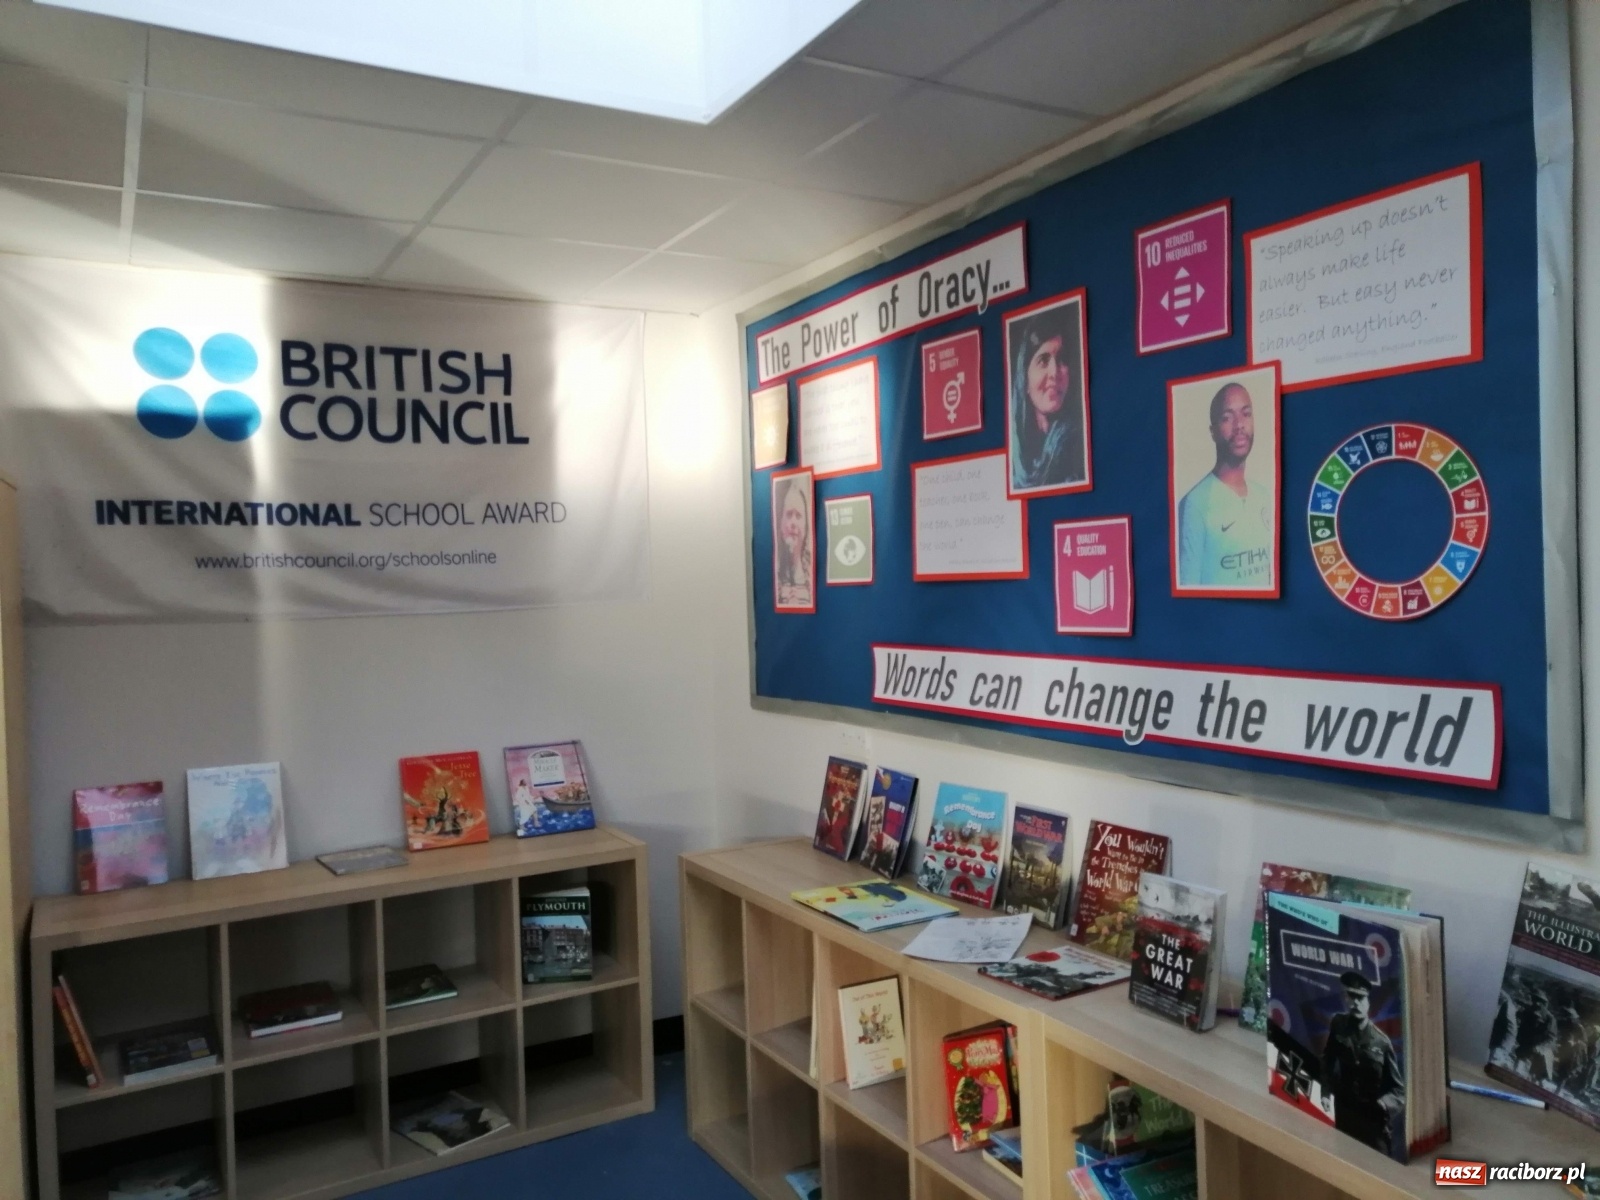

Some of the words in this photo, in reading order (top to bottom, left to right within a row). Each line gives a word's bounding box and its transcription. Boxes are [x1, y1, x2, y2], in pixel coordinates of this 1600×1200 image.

[1351, 220, 1373, 238] up
[1379, 195, 1448, 229] doesn't
[1165, 230, 1194, 249] REDUCED
[1165, 240, 1208, 262] INEQUALITIES
[1145, 241, 1161, 268] 10
[1259, 267, 1316, 292] always
[1321, 252, 1370, 277] make
[1375, 238, 1406, 265] life
[1317, 289, 1349, 310] But
[1354, 279, 1397, 304] easy
[1404, 265, 1459, 290] never
[762, 337, 790, 377] The
[801, 311, 859, 363] Power
[878, 284, 900, 333] of
[1258, 326, 1326, 354] changed
[279, 340, 513, 396] BRITISH
[929, 352, 936, 373] 5
[279, 393, 530, 445] COUNCIL
[95, 499, 361, 527] INTERNATIONAL
[369, 501, 474, 526] SCHOOL
[481, 501, 567, 524] AWARD
[1063, 535, 1072, 557] 4
[1076, 533, 1099, 545] QUALITY
[1076, 544, 1107, 557] EDUCATION
[195, 550, 498, 572] www.britishcouncil.org/schoolsonline
[883, 652, 958, 702] Words
[969, 671, 1023, 711] can
[1044, 667, 1172, 741] change
[1195, 680, 1268, 742] the
[1303, 693, 1473, 769] world
[943, 802, 996, 821] Remembrance
[966, 819, 982, 833] Day
[1015, 821, 1043, 838] WORLD
[1093, 823, 1122, 851] You
[1127, 835, 1165, 861] Wouldn't
[1101, 856, 1138, 875] Trenches
[1086, 868, 1115, 892] World
[1115, 872, 1134, 893] War
[1527, 909, 1549, 923] THE
[1162, 933, 1181, 951] THE
[1524, 918, 1593, 954] WORLD
[1145, 943, 1194, 974] GREAT
[1290, 942, 1326, 963] WORLD
[1328, 950, 1355, 969] WAR
[1151, 963, 1184, 990] WAR
